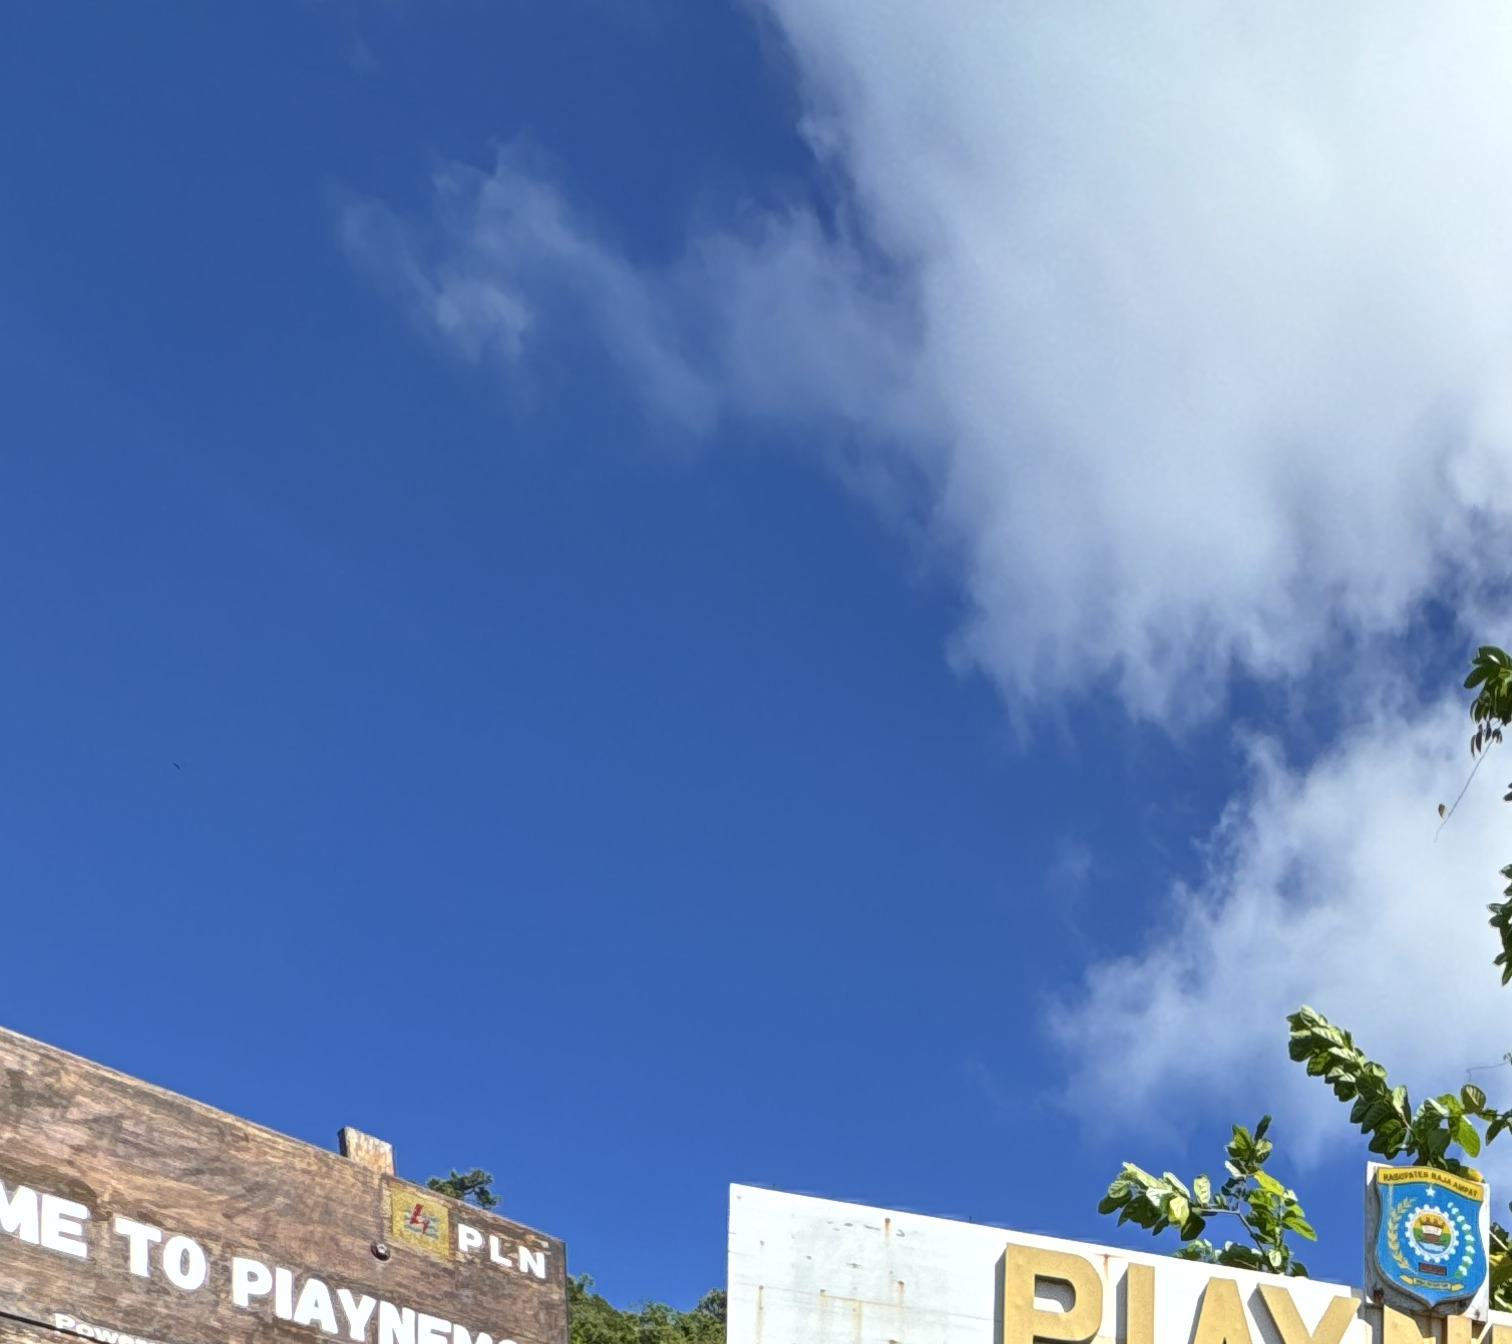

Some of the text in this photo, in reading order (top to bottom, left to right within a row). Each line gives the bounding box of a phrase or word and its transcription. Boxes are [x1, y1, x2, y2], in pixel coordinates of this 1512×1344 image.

[1383, 1172, 1478, 1197] KABUPATEN RAJA AMPAT
[115, 1217, 207, 1290] TO
[457, 1223, 546, 1279] PLN
